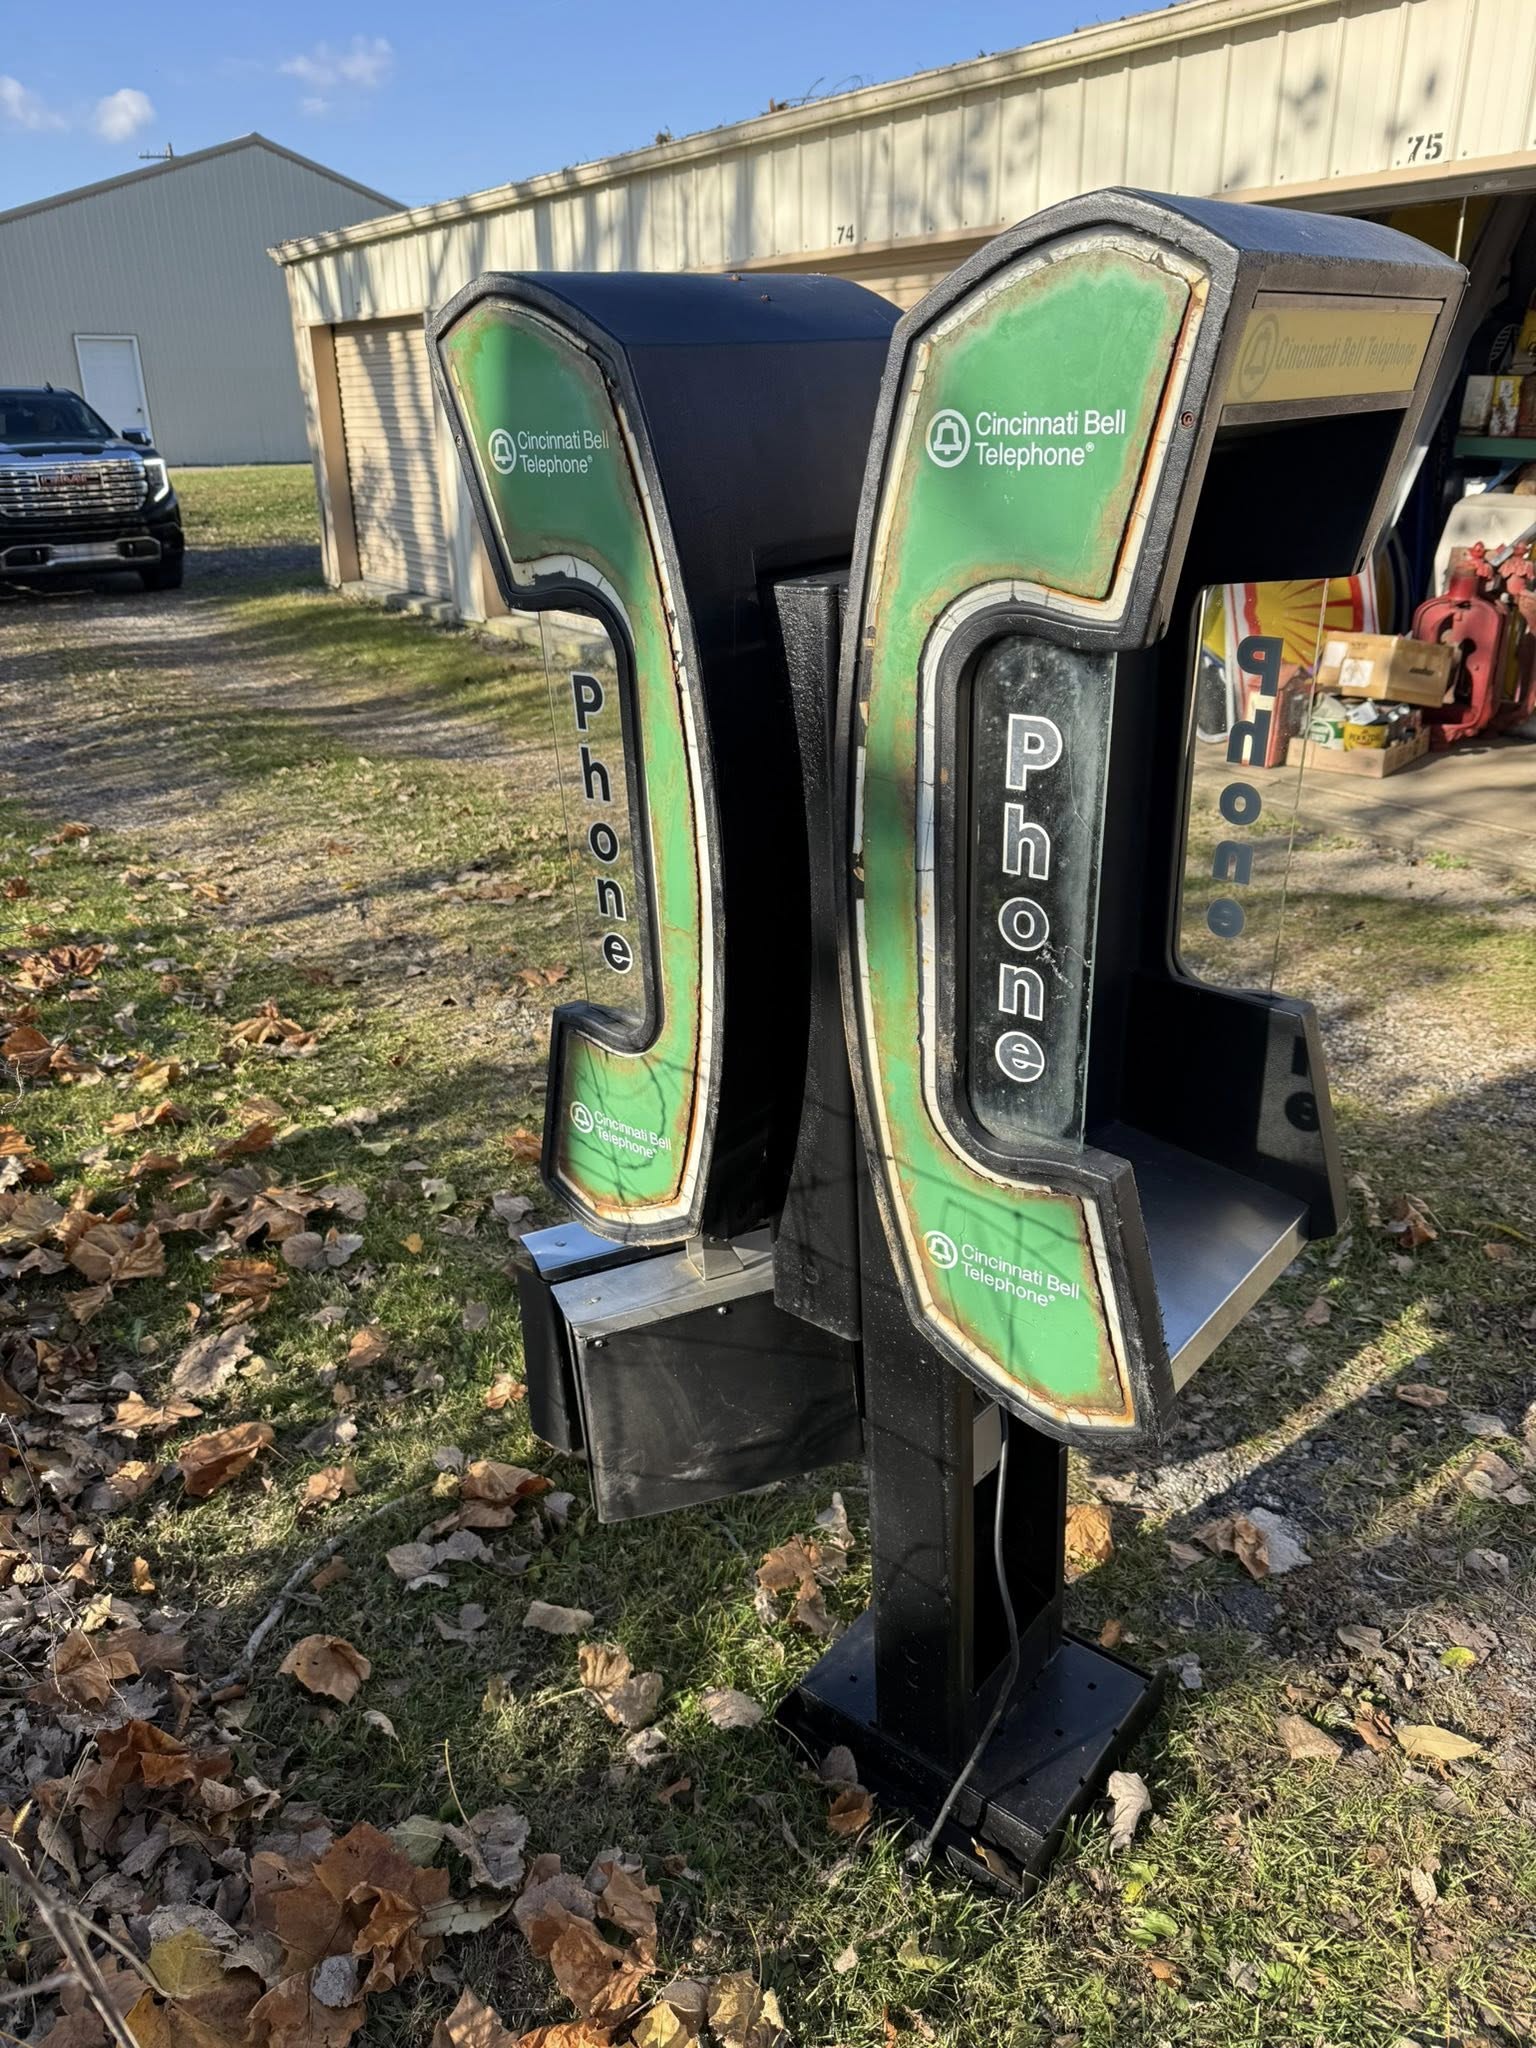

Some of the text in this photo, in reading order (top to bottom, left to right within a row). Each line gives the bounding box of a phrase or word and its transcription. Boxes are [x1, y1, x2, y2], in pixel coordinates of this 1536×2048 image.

[1407, 132, 1443, 164] 75
[837, 224, 855, 244] 74
[1274, 336, 1342, 370] Cincinnati
[1337, 335, 1368, 368] Bell
[517, 429, 610, 450] Cincinnati Bell
[975, 408, 1127, 437] Cincinnati Bell
[570, 671, 634, 975] Phone
[994, 713, 1064, 1083] Phone
[594, 1110, 672, 1151] Cincinnati Bell
[961, 1243, 1080, 1300] Cincinnati Bell
